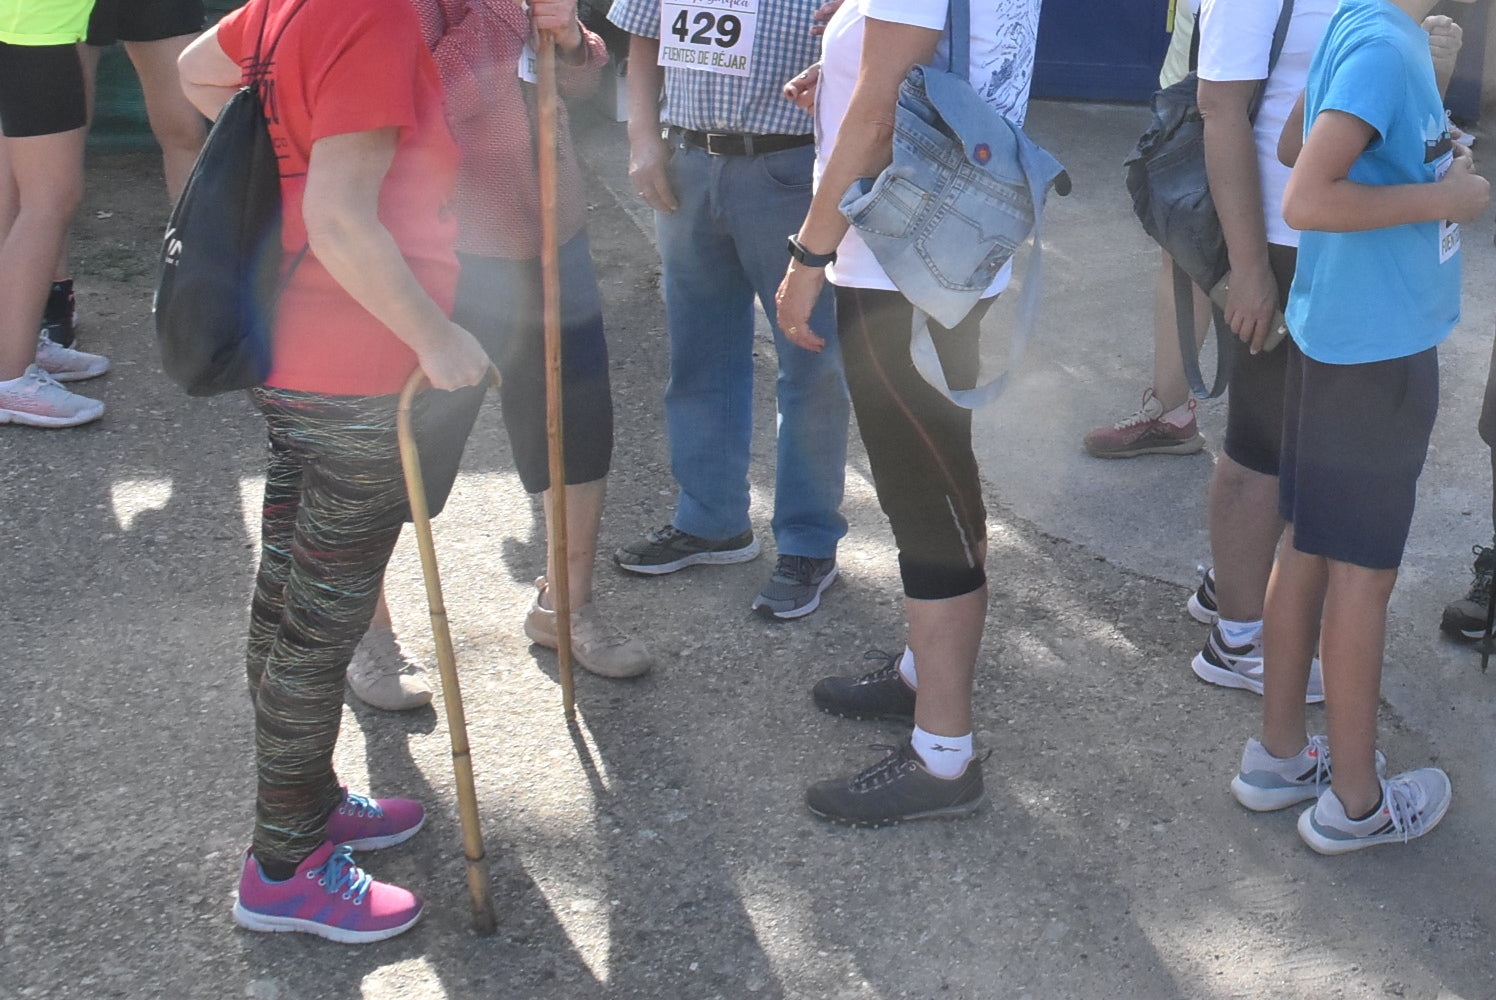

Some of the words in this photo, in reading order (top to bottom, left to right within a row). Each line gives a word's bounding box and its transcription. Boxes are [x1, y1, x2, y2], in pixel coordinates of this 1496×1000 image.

[672, 9, 741, 48] 429
[662, 46, 695, 63] FUENTES
[697, 50, 710, 65] DE
[711, 51, 747, 70] BÉJAR
